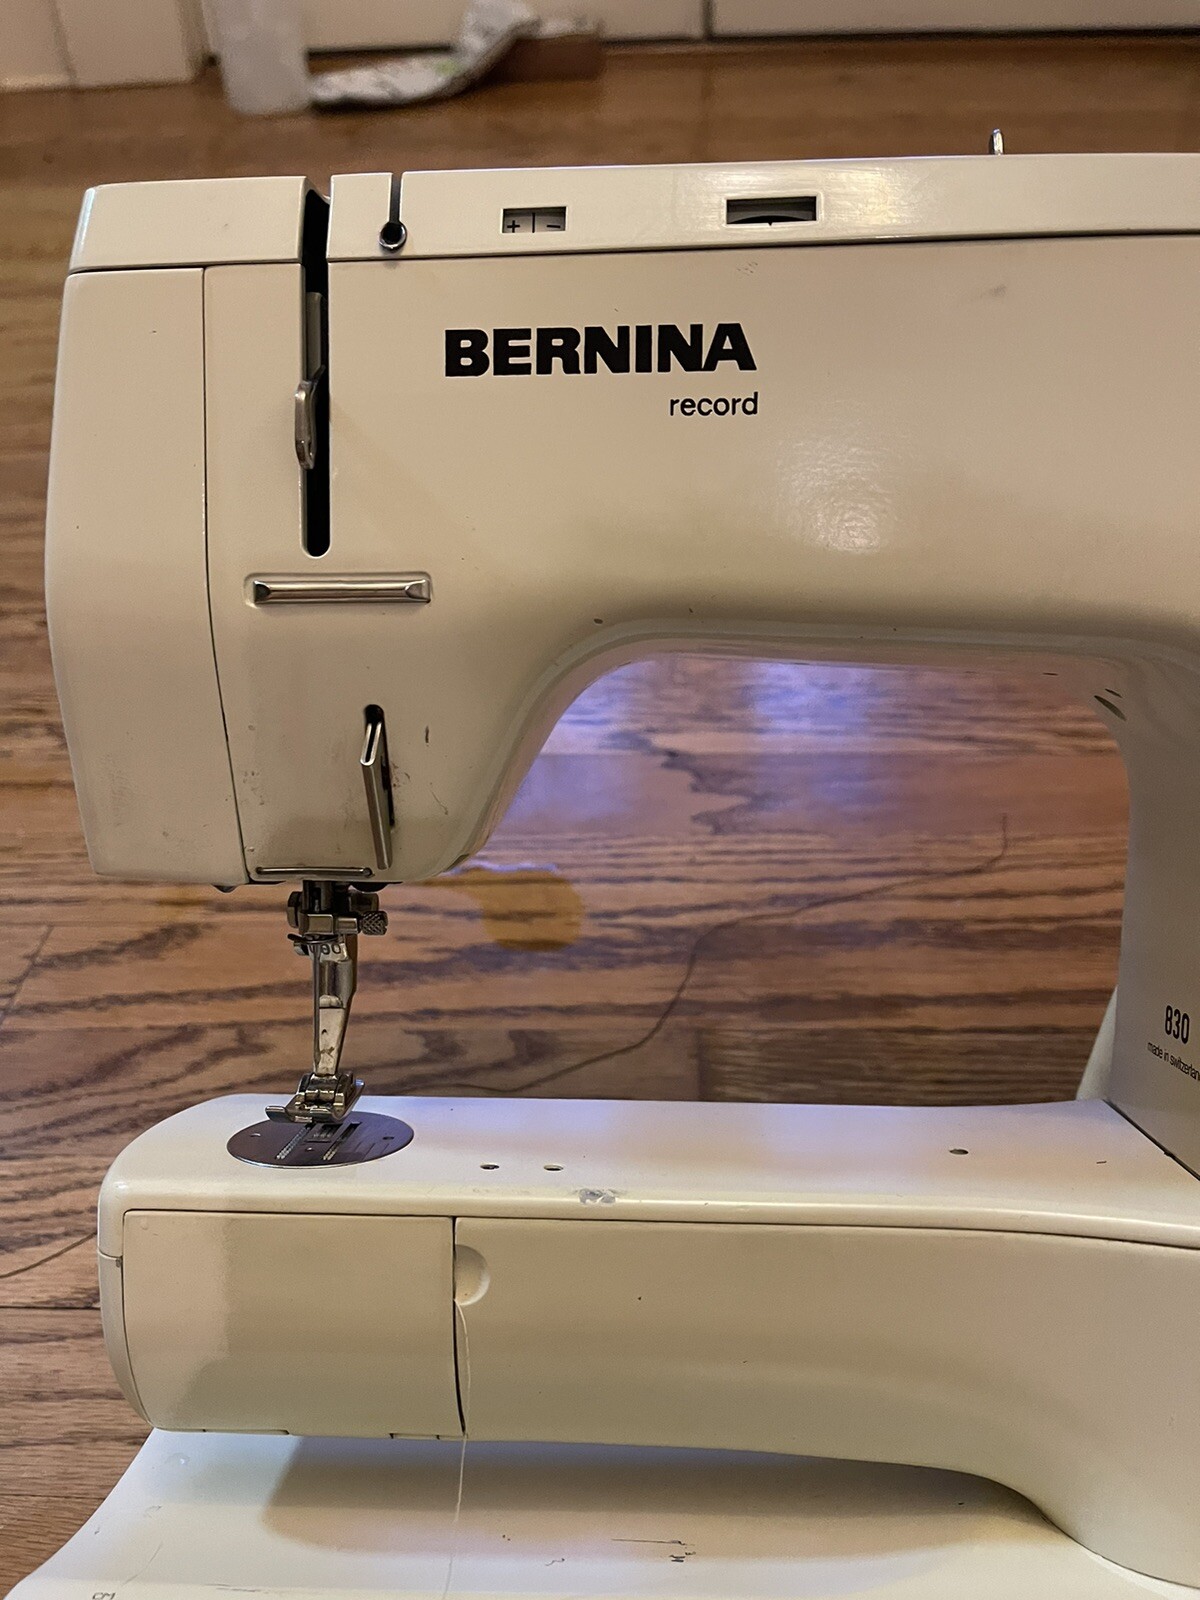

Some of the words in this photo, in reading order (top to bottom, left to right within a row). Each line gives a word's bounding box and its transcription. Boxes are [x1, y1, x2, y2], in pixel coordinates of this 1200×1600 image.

[445, 323, 757, 376] BERNINA
[669, 392, 759, 416] record
[1165, 1005, 1190, 1044] 830
[1147, 1042, 1163, 1059] made
[1163, 1049, 1170, 1062] in
[1170, 1055, 1200, 1081] switzerlan
